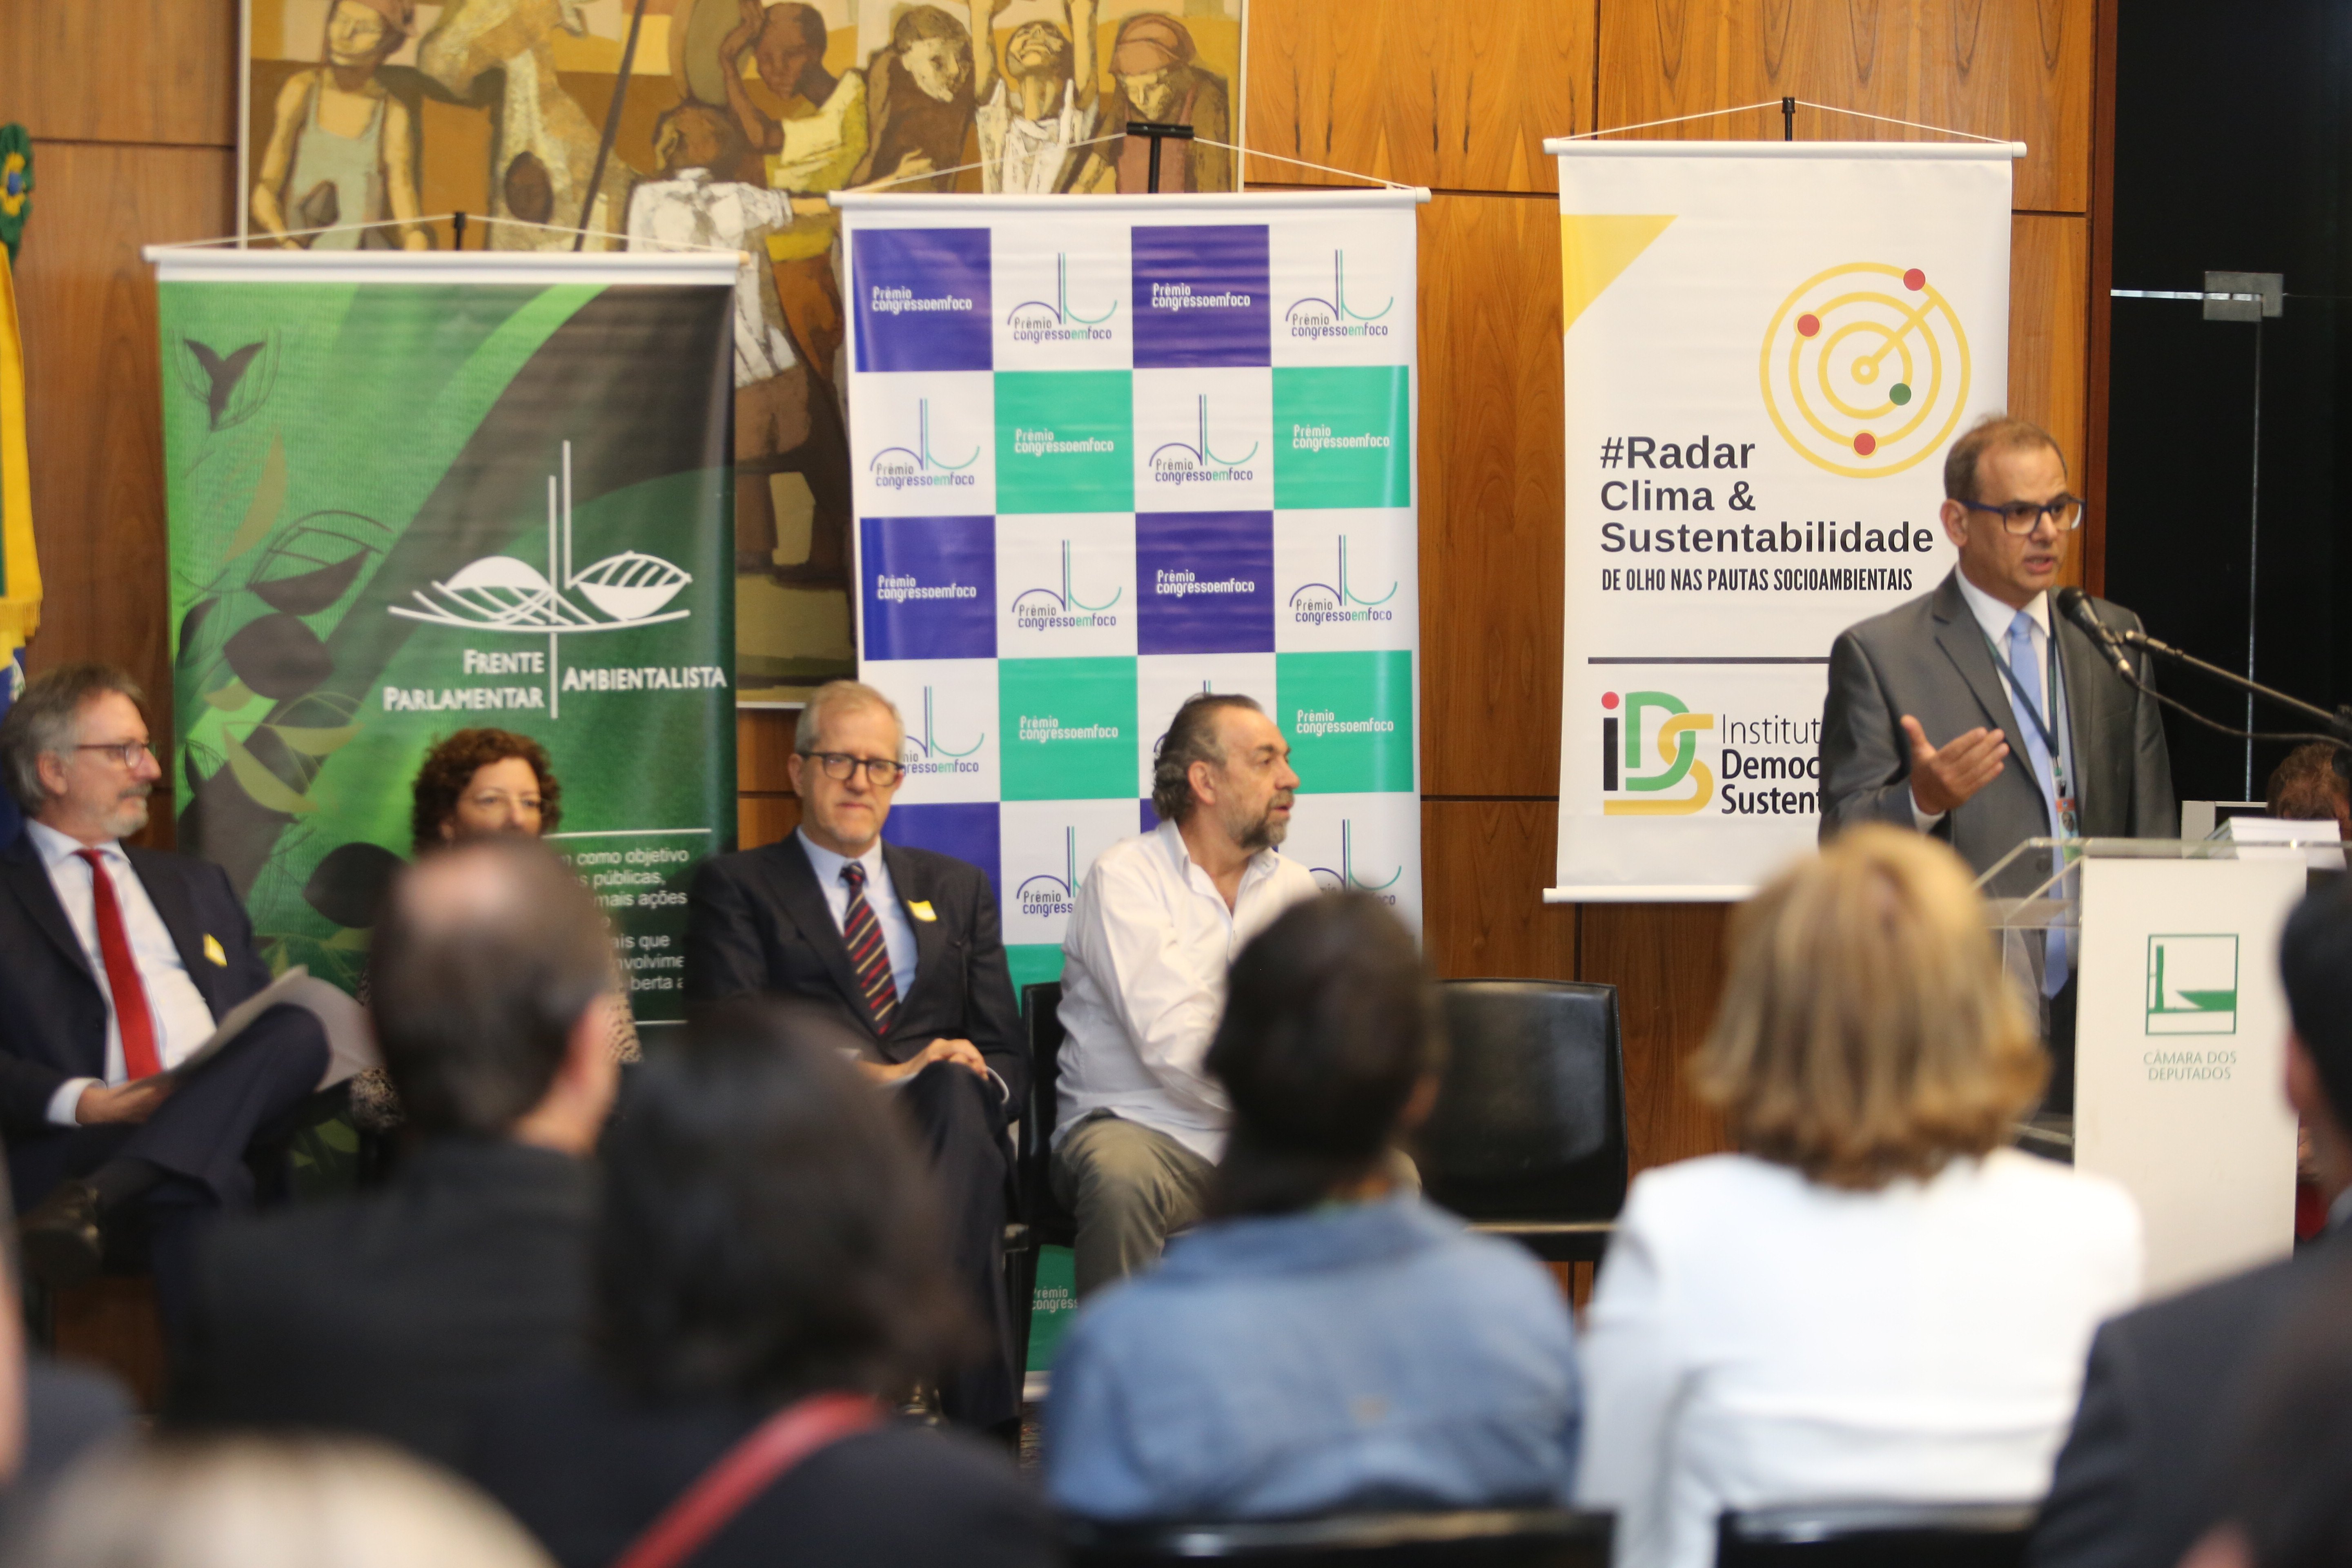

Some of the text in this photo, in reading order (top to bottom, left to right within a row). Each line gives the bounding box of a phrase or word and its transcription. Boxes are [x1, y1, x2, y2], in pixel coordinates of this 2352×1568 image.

[873, 286, 911, 298] Prêmio
[1153, 283, 1190, 296] Prêmio
[872, 293, 972, 314] congressoemfoco
[1152, 291, 1250, 311] congressoemfoco
[1015, 318, 1051, 329] Prêmio
[1293, 314, 1329, 325] Prêmio
[1014, 325, 1111, 343] congressoemfoco
[1292, 321, 1388, 340] congressoemfoco
[1016, 429, 1054, 441] Prêmio
[1294, 425, 1331, 437] Prêmio
[1015, 437, 1114, 457] congressoemfoco
[1293, 432, 1390, 452] congressoemfoco
[1601, 435, 1755, 468] #Radar
[877, 463, 913, 475] Prêmio
[1157, 459, 1193, 470] Prêmio
[876, 471, 974, 490] congressoemfoco
[1156, 466, 1252, 485] congressoemfoco
[1601, 480, 1755, 510] Clima &
[1601, 521, 1933, 552] Sustentabilidade
[878, 575, 915, 587] Prêmio
[1158, 569, 1195, 582] Prêmio
[1603, 569, 1912, 590] DE OLHO NAS PAUTAS SOCIOAMBIENTAIS
[878, 582, 976, 603] congressoemfoco
[1156, 577, 1254, 597] congressoemfoco
[1019, 605, 1056, 616] Prêmio
[1297, 599, 1332, 610] Prêmio
[1018, 611, 1116, 631] congressoemfoco
[1296, 606, 1392, 625] congressoemfoco
[464, 650, 543, 673] FRENTE
[562, 667, 726, 690] AMBIENTALISTA
[384, 687, 543, 710] PARLAMENTAR
[1020, 716, 1058, 728] Prêmio
[1298, 710, 1334, 722] Prêmio
[1019, 723, 1118, 743] congressoemfoco
[1296, 717, 1394, 737] congressoemfoco
[577, 851, 622, 865] como
[626, 848, 690, 867] objetivo
[593, 869, 666, 889] públicas,
[637, 890, 688, 909] ações
[1023, 890, 1061, 903] Prêmio
[638, 935, 670, 951] que
[2143, 1049, 2236, 1065] CÂMARA DOS
[2149, 1067, 2230, 1080] DEPUTADOS
